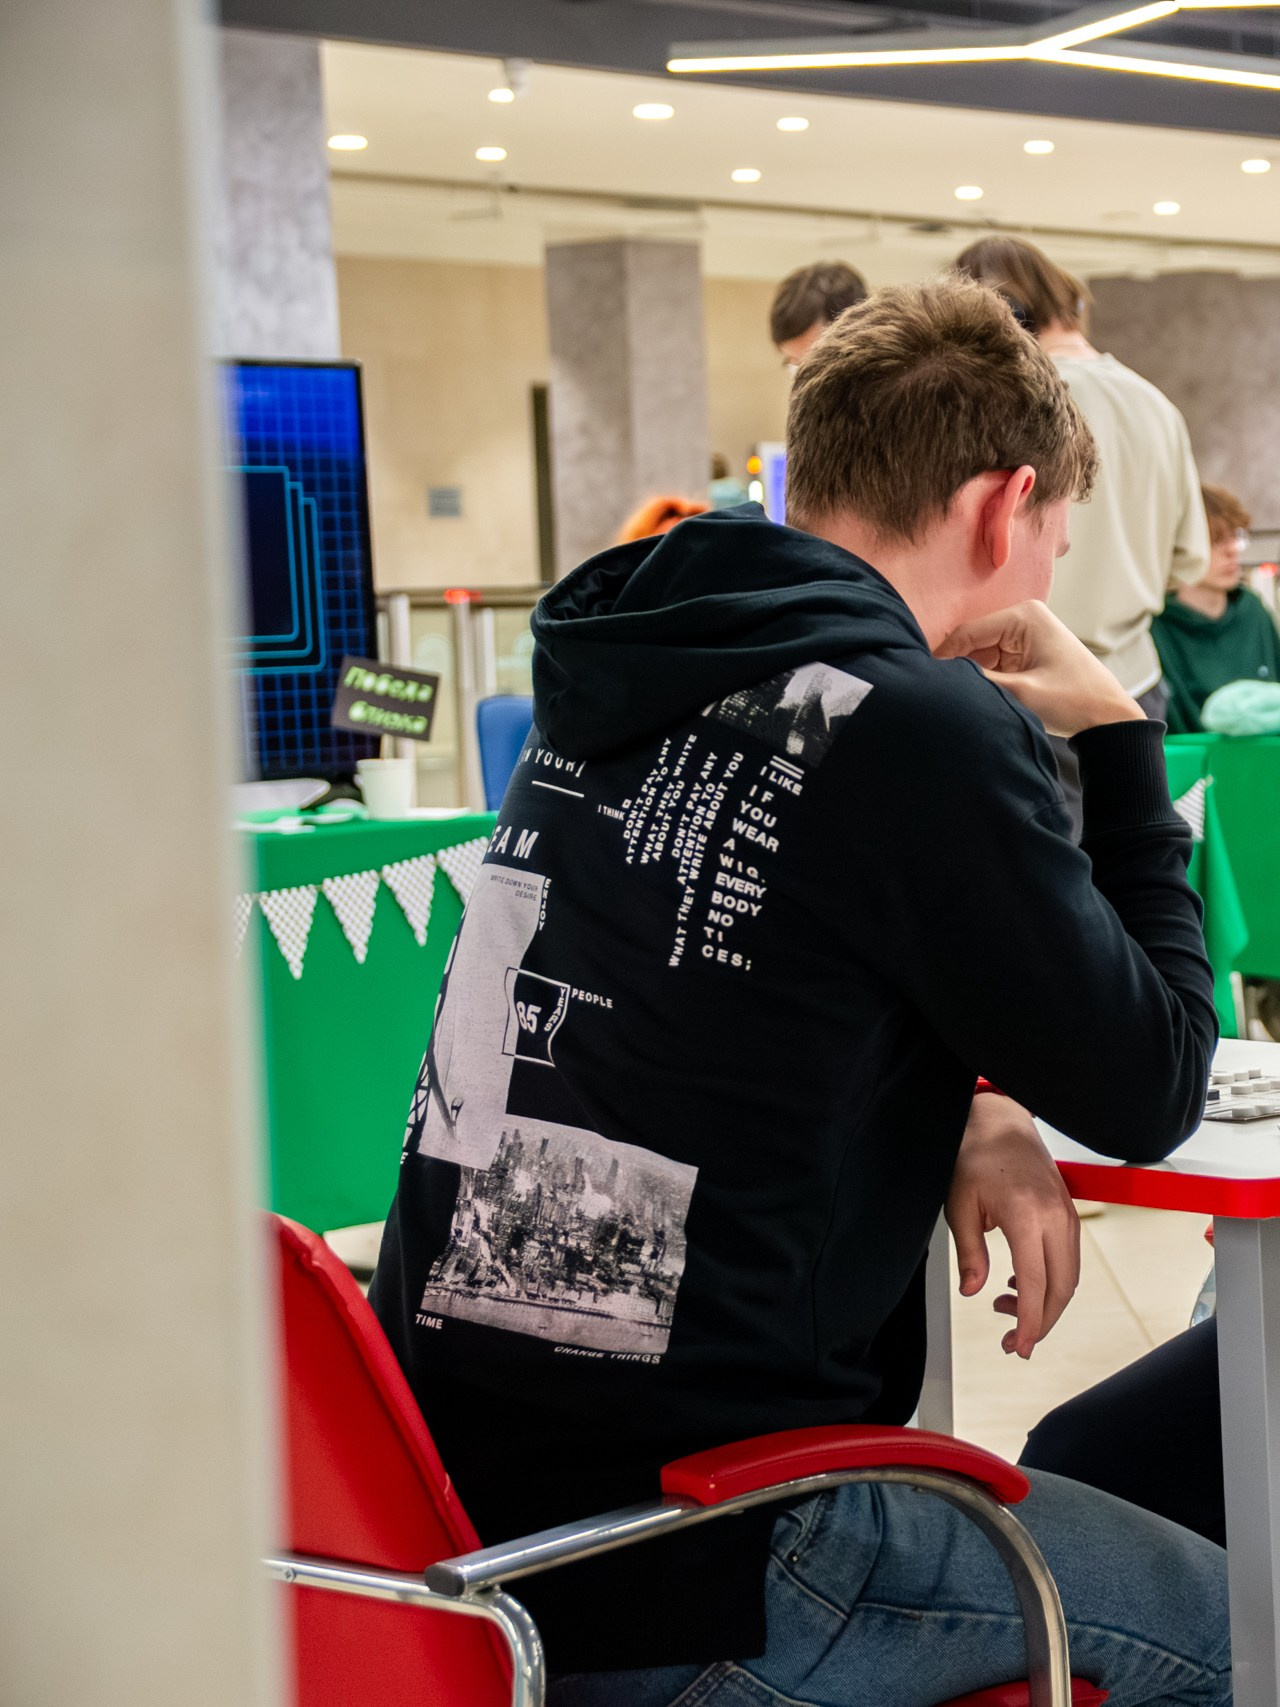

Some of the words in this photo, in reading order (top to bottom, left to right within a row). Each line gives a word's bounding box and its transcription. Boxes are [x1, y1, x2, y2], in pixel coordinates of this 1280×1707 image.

[723, 752, 744, 779] YOU
[623, 797, 644, 839] DON'T
[641, 768, 659, 793] PAY
[658, 737, 672, 765] ANY
[749, 785, 774, 804] IF
[760, 766, 768, 777] I
[769, 770, 803, 796] LIKE
[603, 805, 626, 821] THINK
[640, 823, 659, 864] WHAT
[655, 782, 675, 817] THEY
[673, 734, 697, 776] WRITE
[672, 814, 690, 858] DON'T
[686, 782, 702, 810] PAY
[700, 752, 718, 780] ANY
[703, 782, 728, 830] ABOUT
[626, 787, 657, 864] ATTENTION
[655, 767, 669, 783] TO
[652, 813, 672, 861] ABOUT
[668, 780, 685, 808] YOU
[740, 802, 777, 828] YOU
[677, 805, 706, 885] ATTENTION
[701, 783, 715, 800] TO
[723, 837, 736, 851] A
[732, 818, 779, 853] WEAR
[689, 834, 708, 879] WRITE
[505, 879, 522, 888] DOWN
[523, 883, 538, 891] YOUR
[515, 890, 537, 901] DESIRE
[715, 872, 768, 898] EVERY
[539, 878, 552, 931] ENJOY
[677, 886, 696, 921] THEY
[708, 909, 734, 927] NO
[711, 891, 762, 917] BODY
[668, 927, 688, 967] WHAT
[703, 926, 723, 942] TI
[544, 987, 566, 1032] YEARS
[571, 988, 613, 1008] PEOPLE
[516, 1001, 542, 1034] 85
[415, 1313, 443, 1329] TIME
[553, 1346, 605, 1358] CHANGE
[610, 1353, 661, 1365] THINGS
